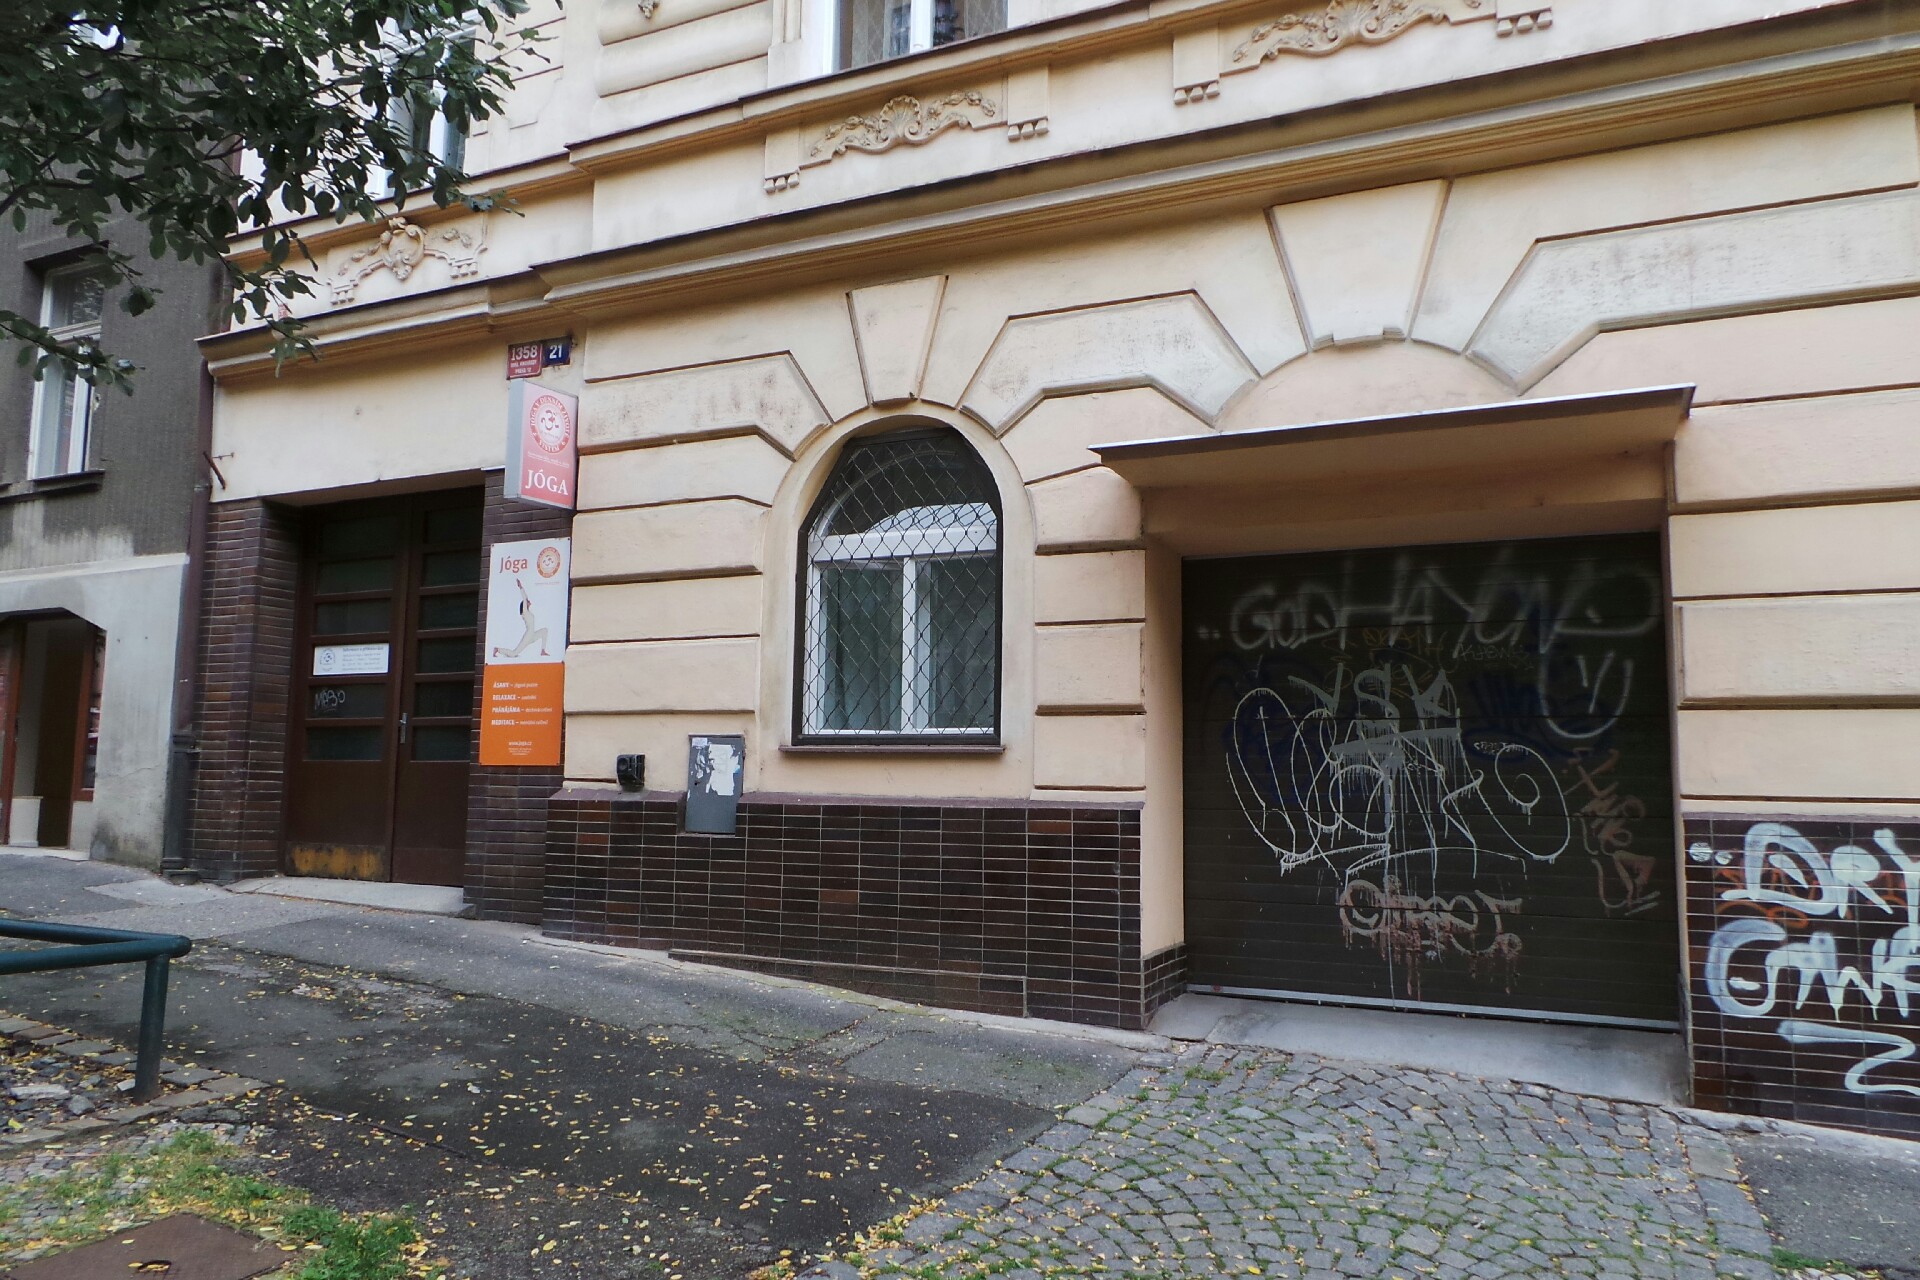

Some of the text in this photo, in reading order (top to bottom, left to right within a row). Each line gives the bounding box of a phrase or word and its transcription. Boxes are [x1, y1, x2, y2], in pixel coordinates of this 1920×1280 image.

[510, 345, 538, 361] 1358
[549, 344, 563, 359] 21
[525, 469, 569, 495] JÓGA
[499, 556, 528, 574] Jóga
